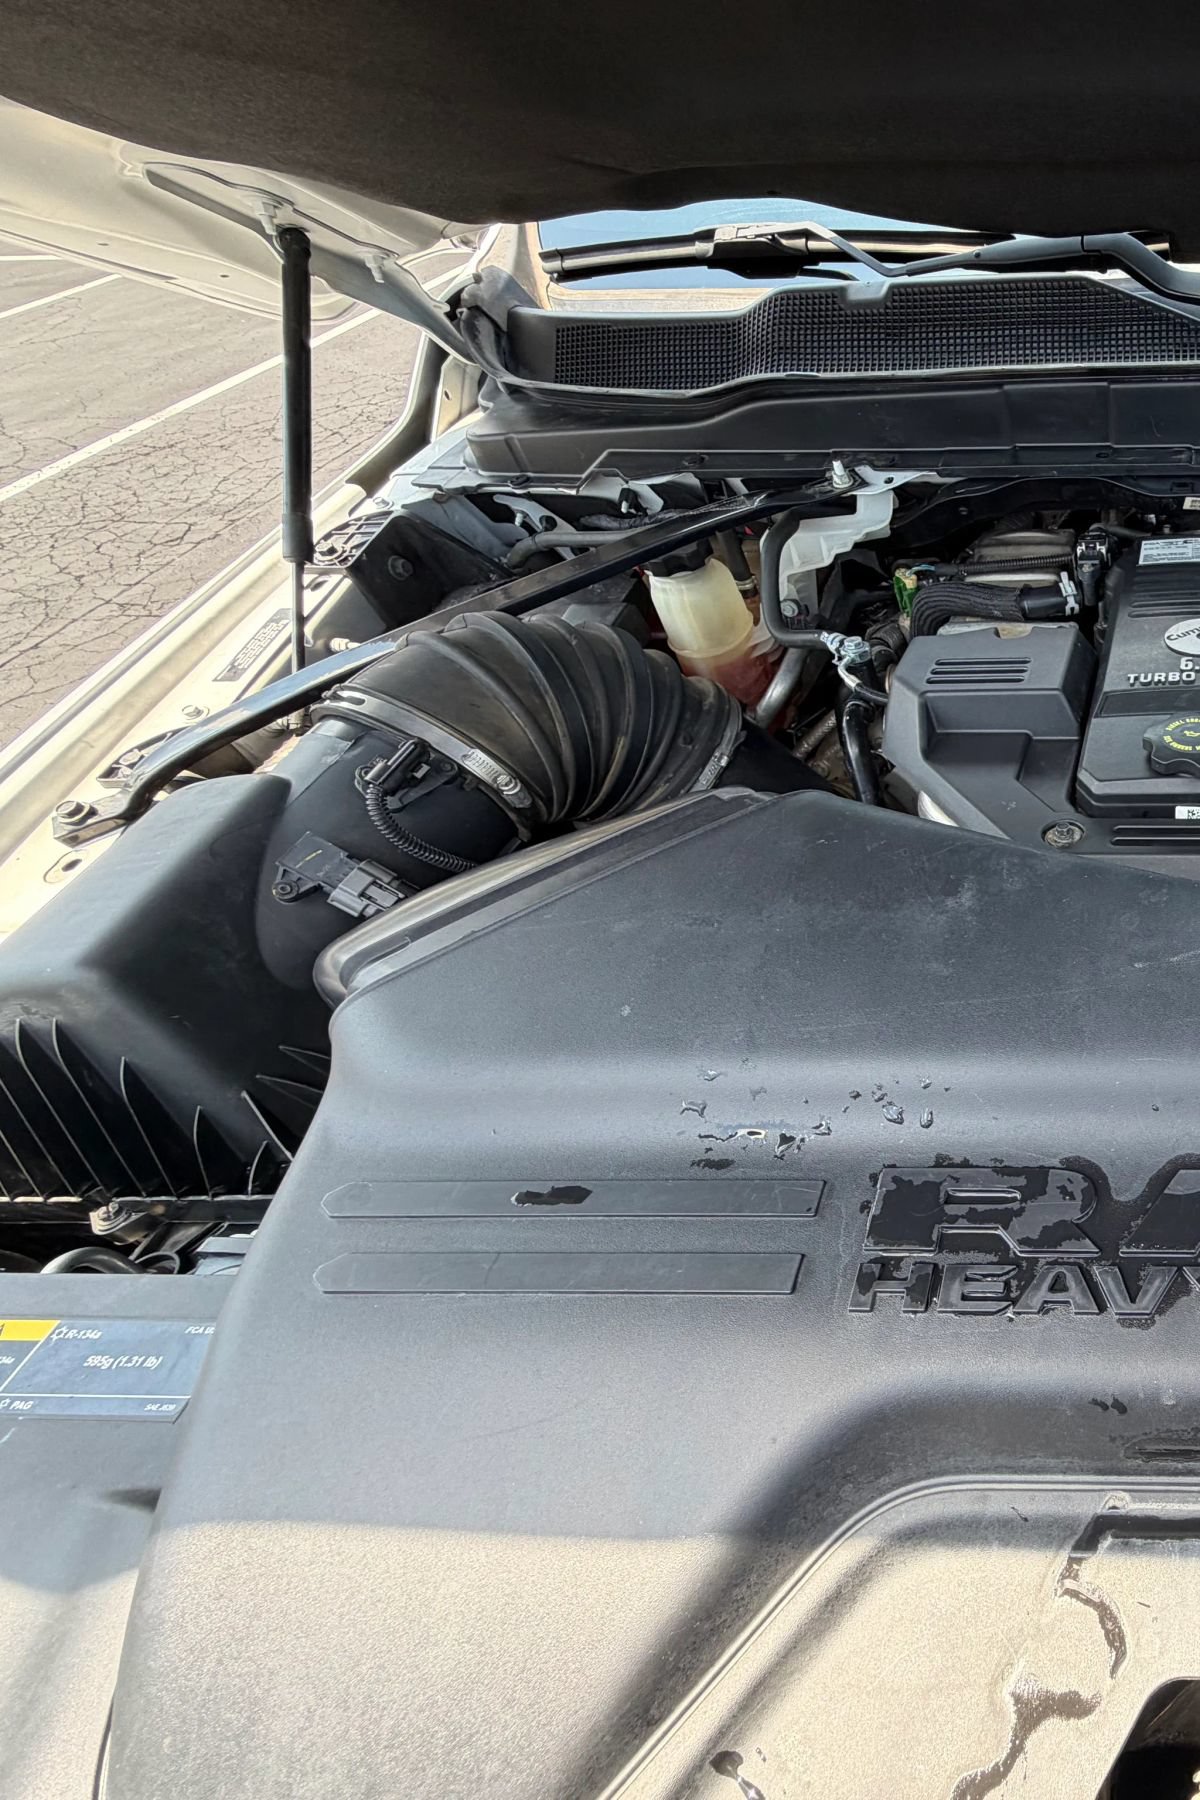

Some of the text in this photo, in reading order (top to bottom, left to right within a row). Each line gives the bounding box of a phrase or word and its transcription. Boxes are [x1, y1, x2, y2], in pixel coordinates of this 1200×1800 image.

[1127, 671, 1196, 685] TURBO
[64, 1329, 103, 1339] R-134a
[184, 1326, 205, 1334] FCA
[83, 1355, 163, 1370] 595g (1.31 lb)
[9, 1400, 33, 1410] PAG
